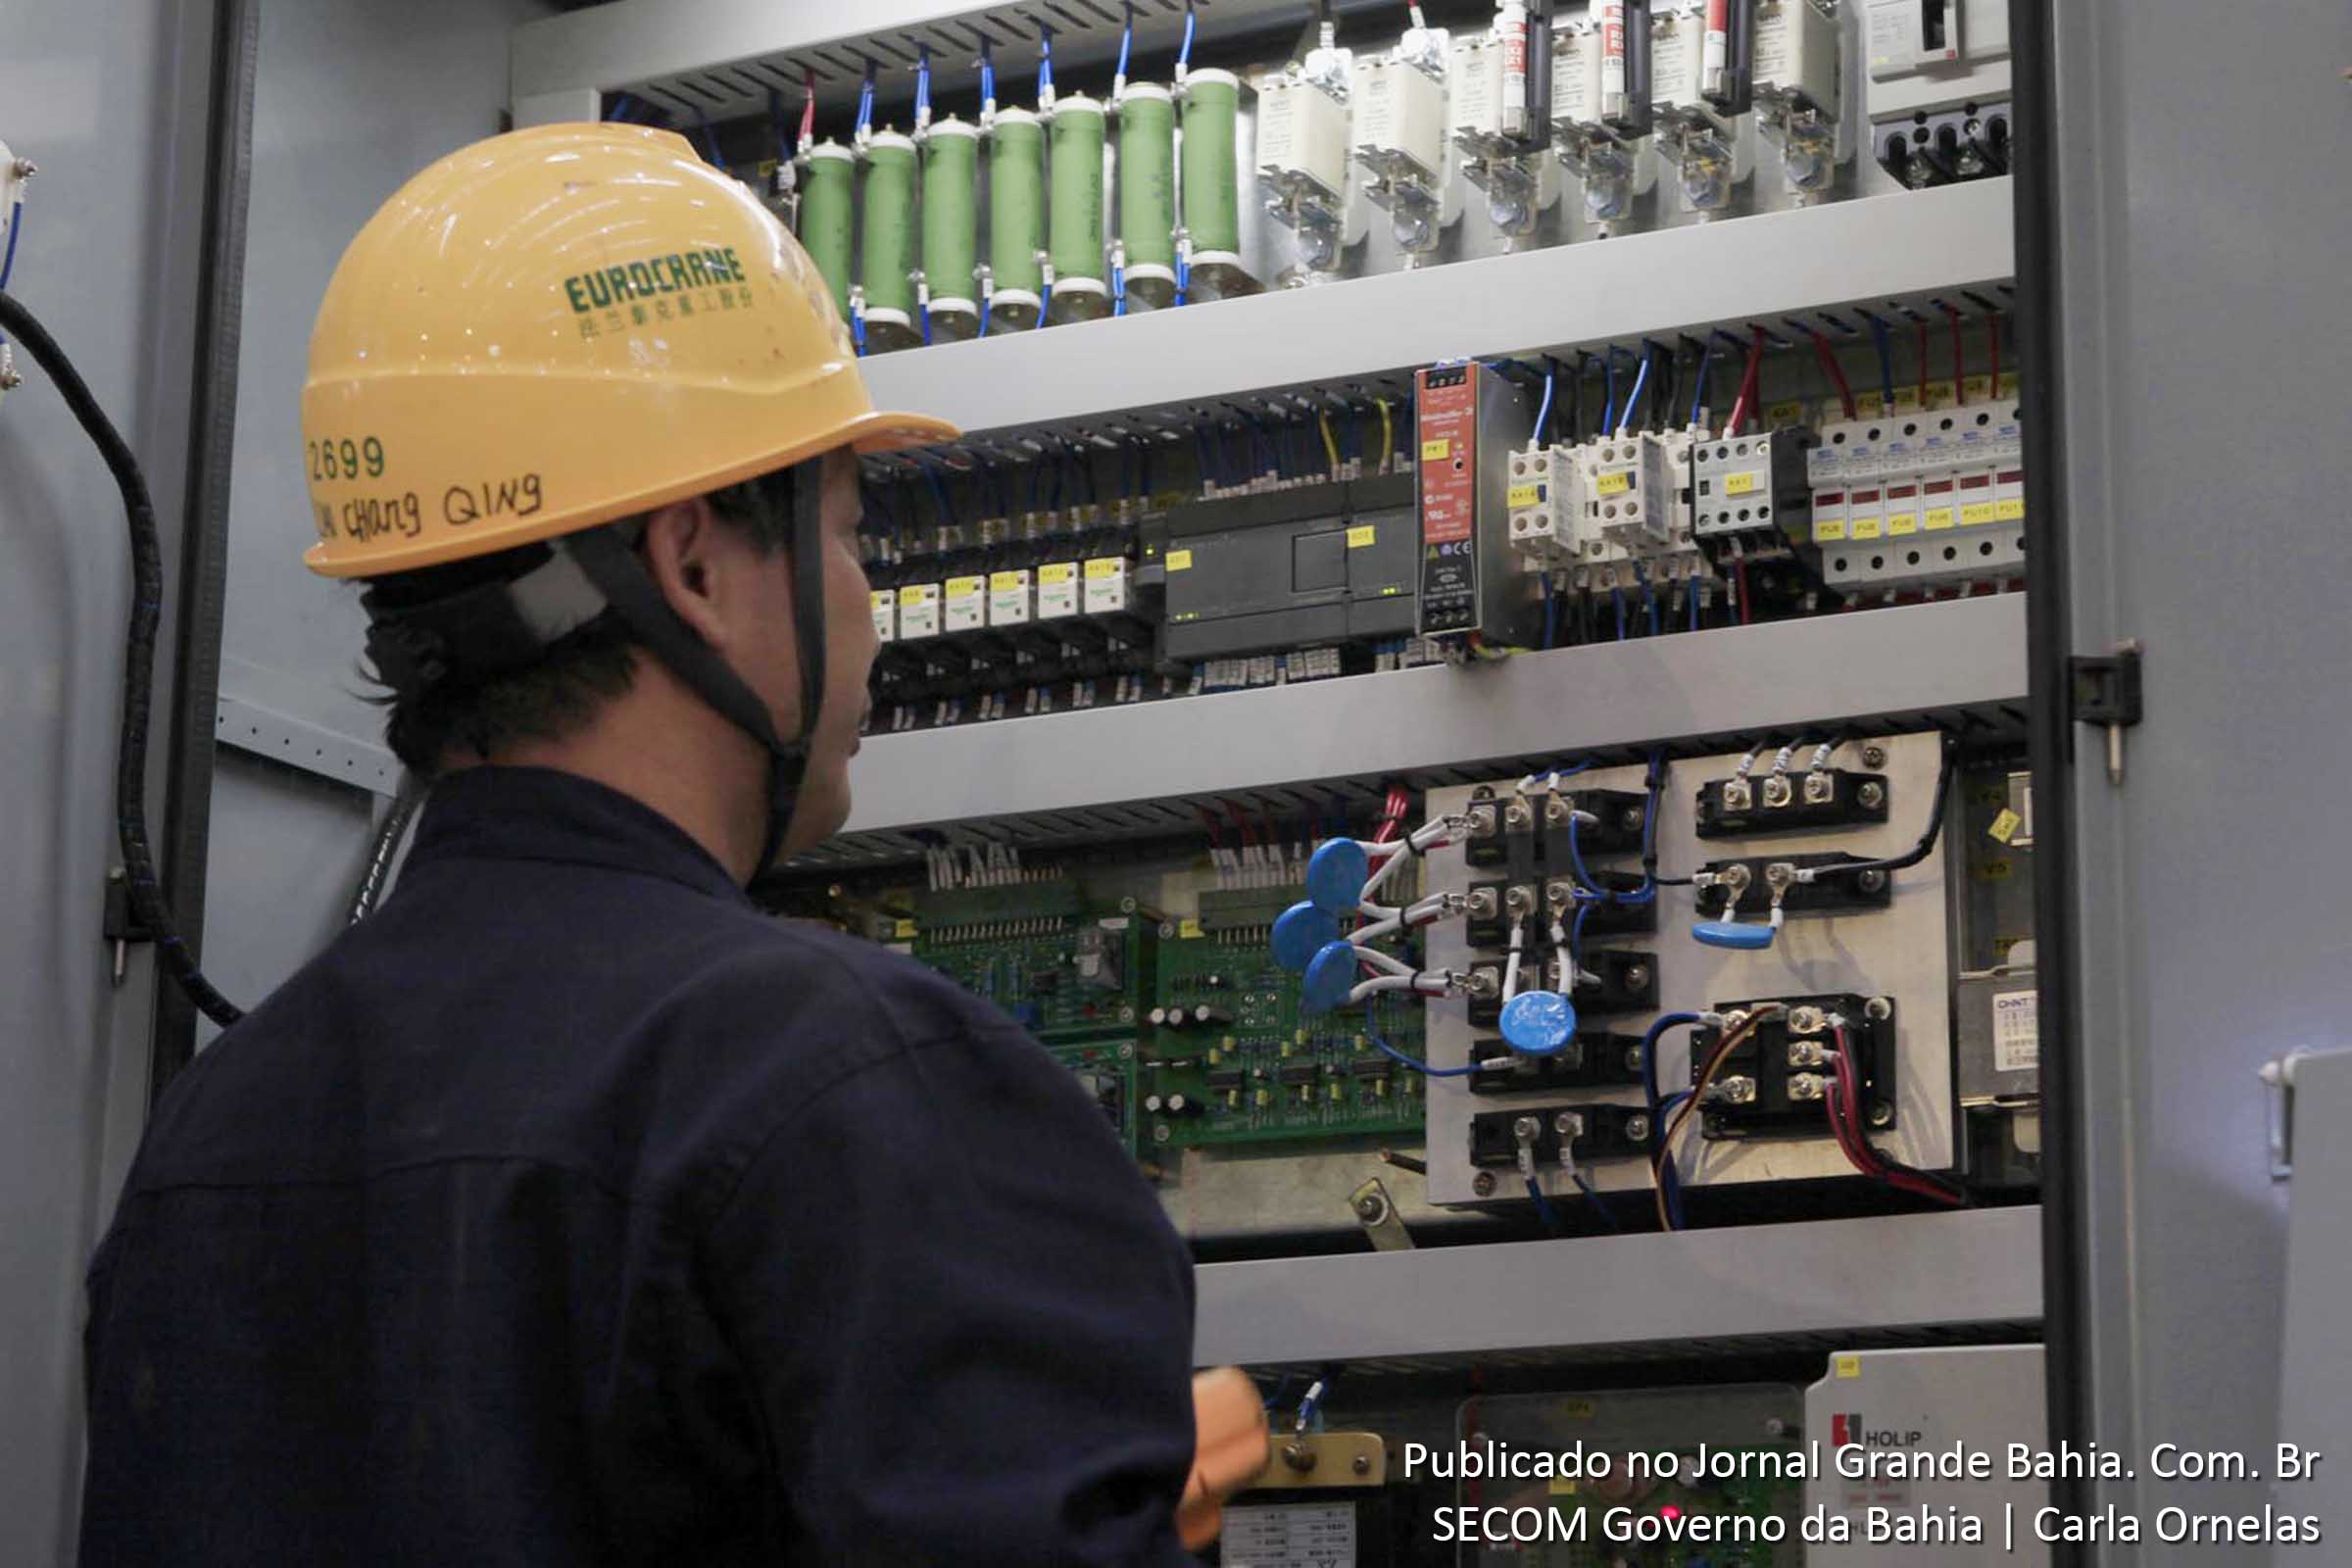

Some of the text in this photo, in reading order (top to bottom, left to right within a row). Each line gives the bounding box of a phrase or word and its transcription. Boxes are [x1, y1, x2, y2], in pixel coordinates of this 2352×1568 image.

[564, 247, 745, 314] EUROCRANE
[307, 436, 384, 481] 2699
[1865, 1431, 1922, 1446] HOLIP
